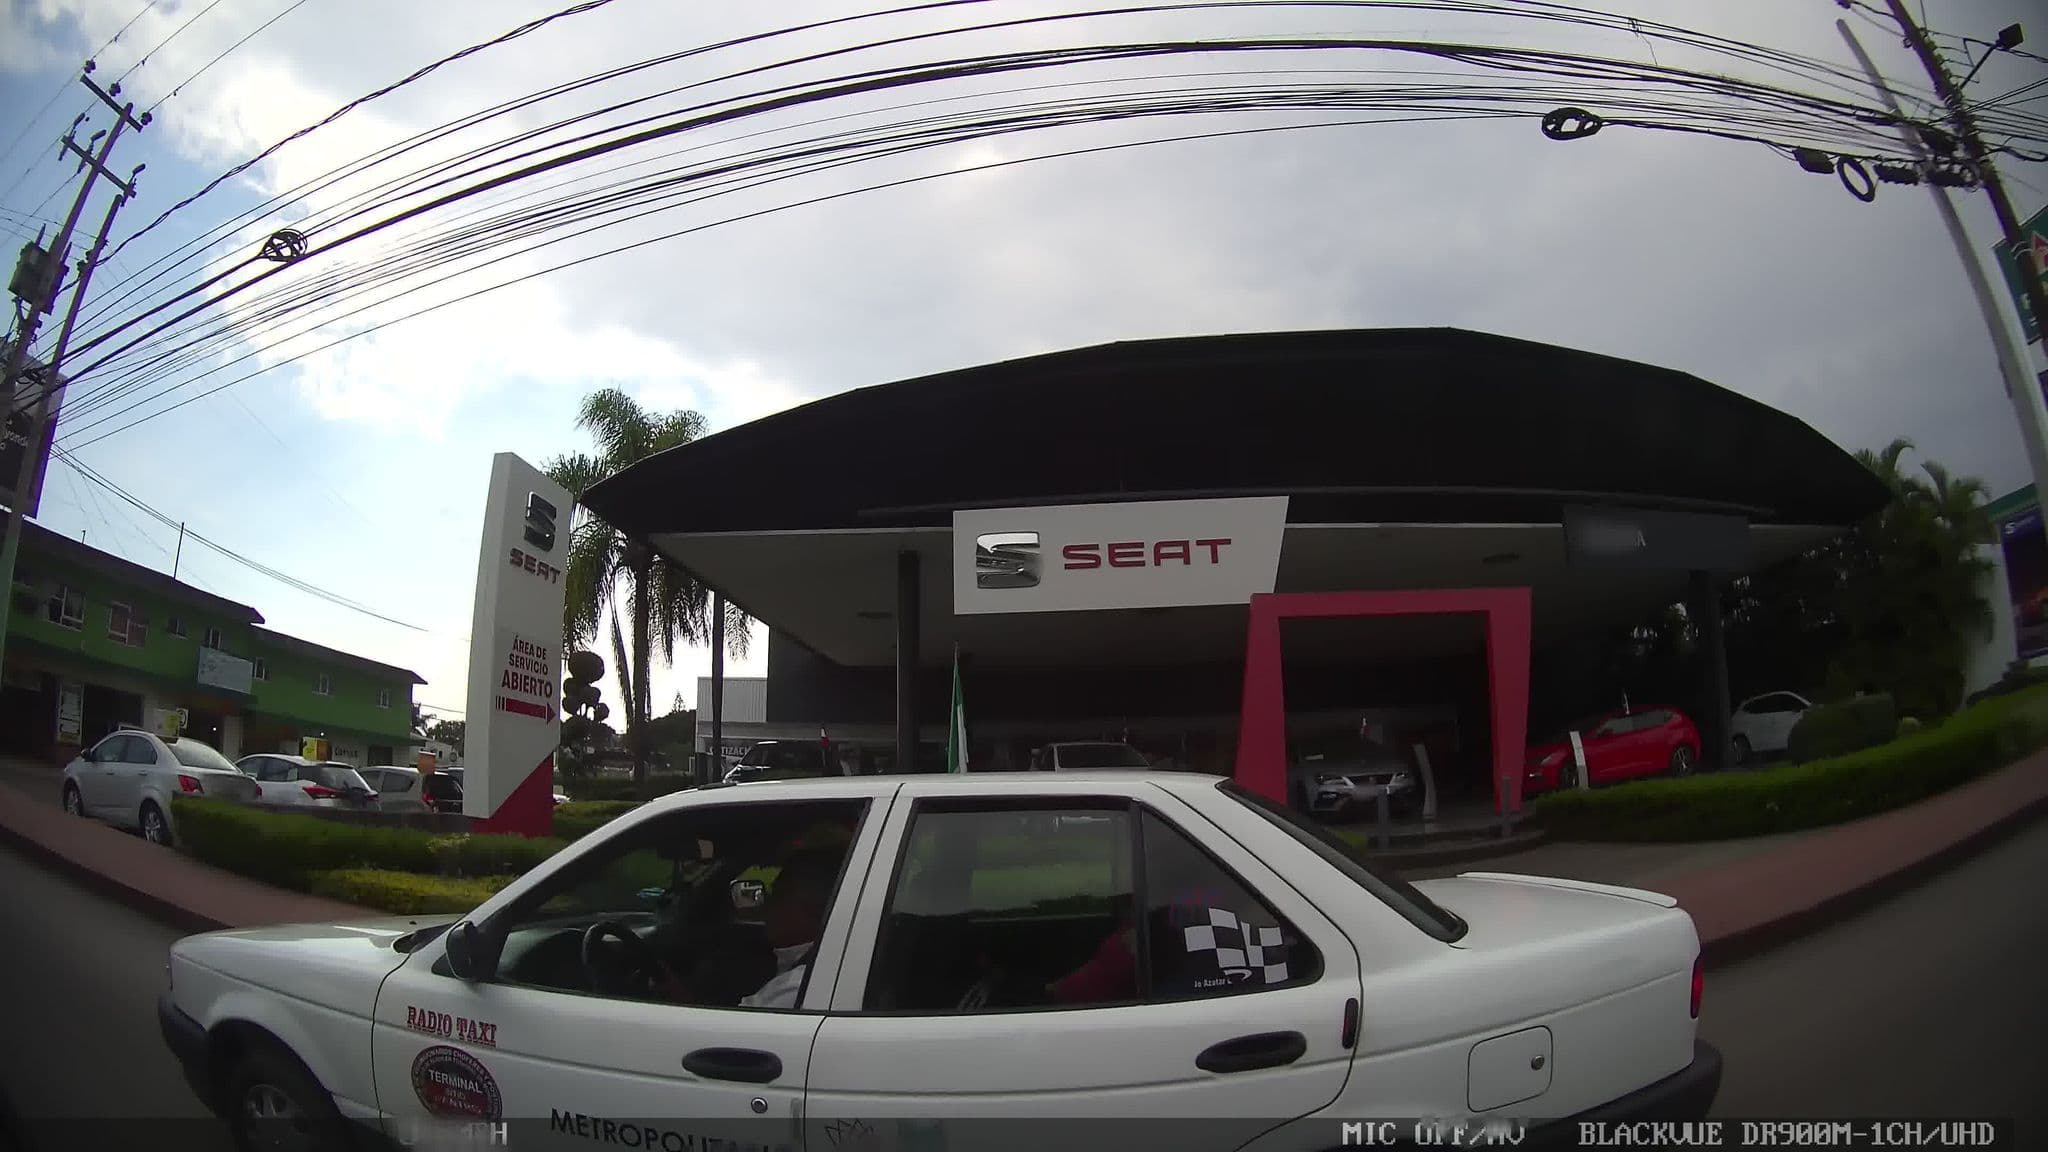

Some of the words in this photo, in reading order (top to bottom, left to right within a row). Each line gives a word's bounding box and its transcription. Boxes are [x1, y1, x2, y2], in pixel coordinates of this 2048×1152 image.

[509, 547, 561, 585] SEAT
[1062, 538, 1232, 570] SEAT
[512, 635, 535, 658] ÁREA
[535, 645, 547, 661] DE
[508, 653, 549, 676] SERVICIO
[501, 669, 553, 699] ABIERTO
[407, 1005, 453, 1036] RADIO
[456, 1016, 497, 1046] TAXI
[427, 1068, 484, 1094] TERMINAL
